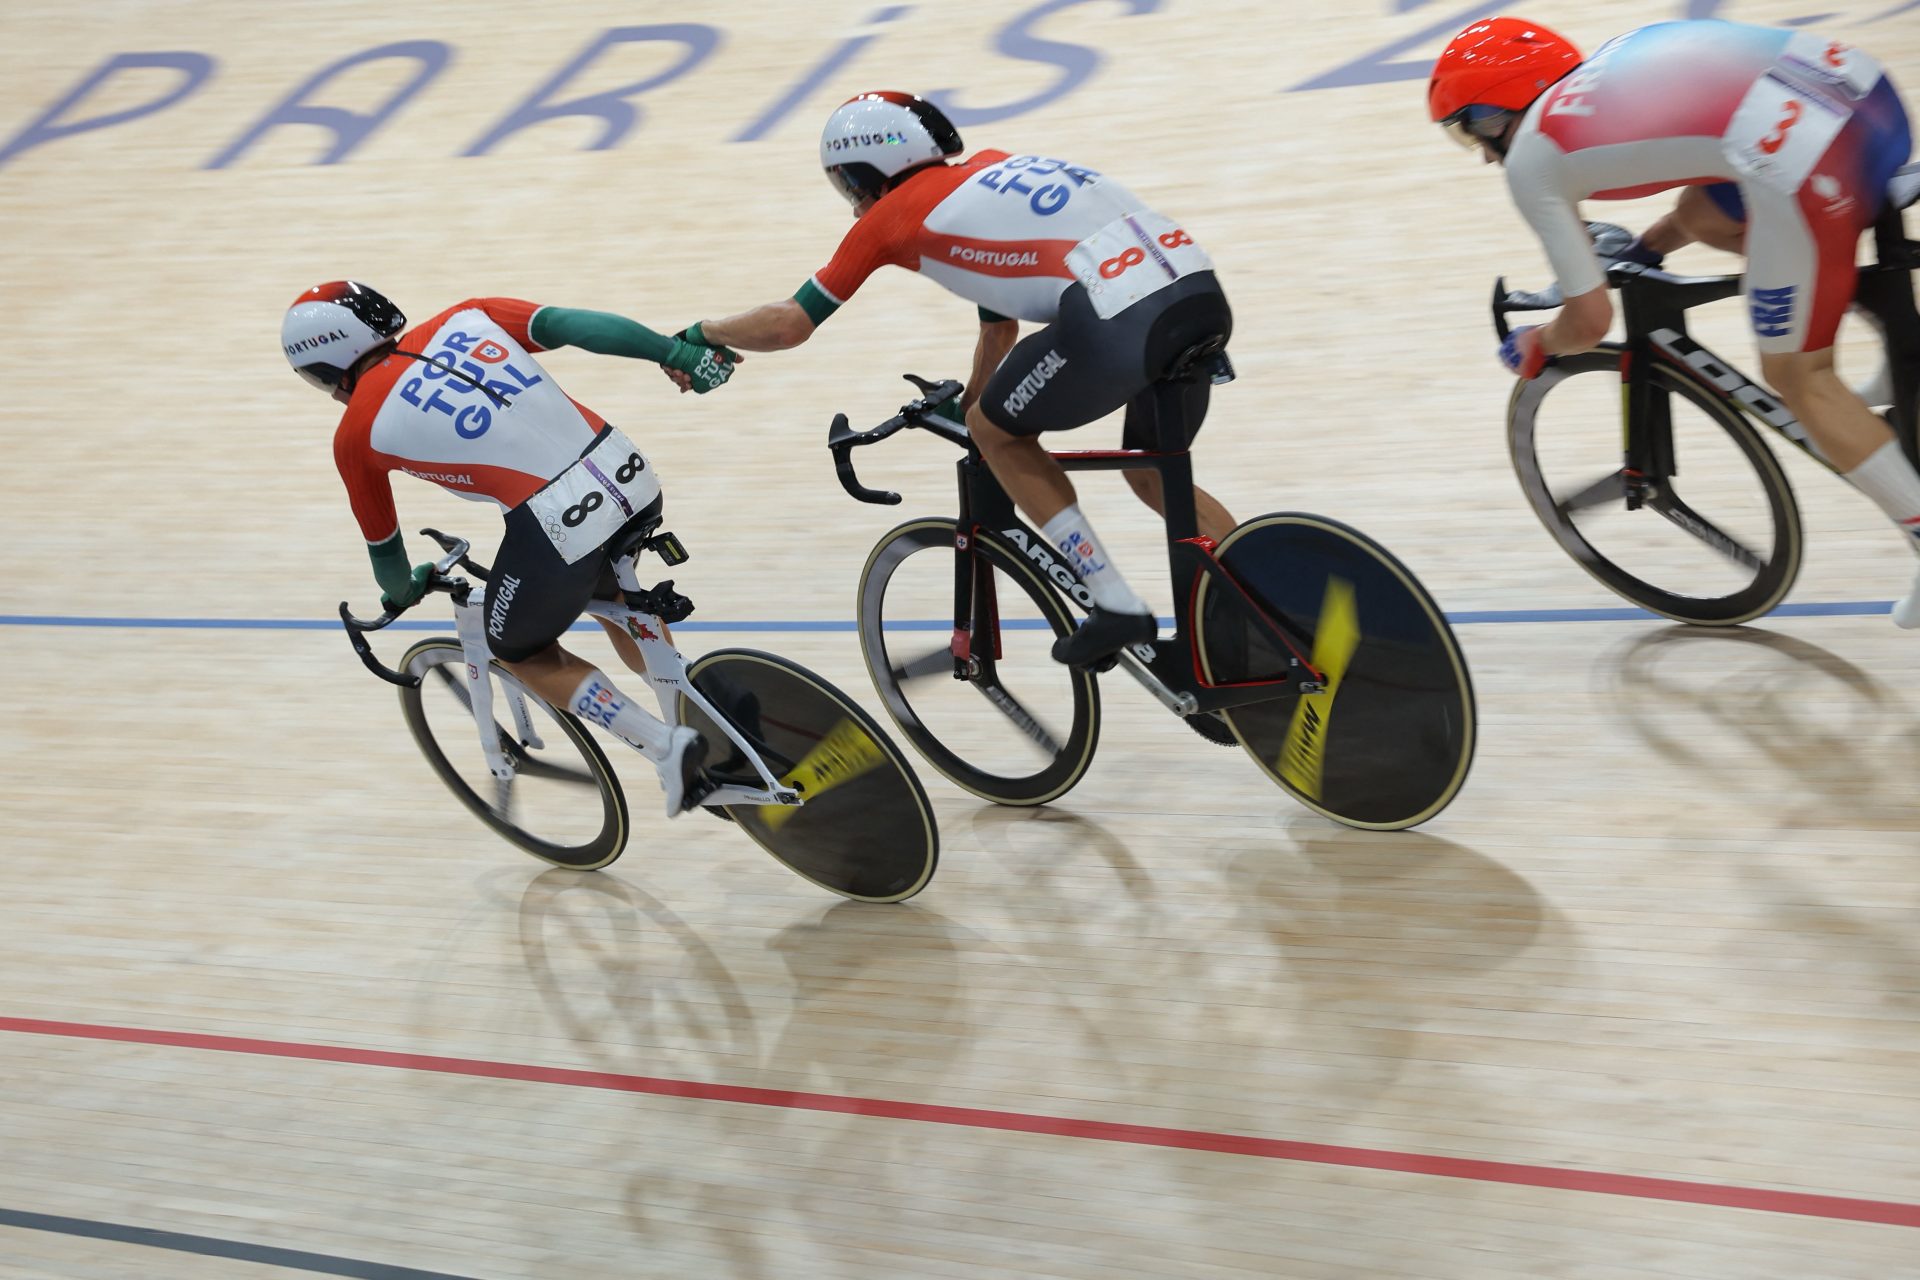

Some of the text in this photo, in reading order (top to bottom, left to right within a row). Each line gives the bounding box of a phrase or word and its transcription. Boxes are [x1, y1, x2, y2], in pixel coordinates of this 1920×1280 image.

[825, 131, 908, 151] PORTUGAL
[1758, 100, 1803, 154] 3
[977, 156, 1039, 190] PO
[1030, 166, 1103, 216] GA
[949, 245, 1039, 266] PORTUGAL
[1099, 246, 1146, 280] 8
[400, 331, 481, 407] POR
[694, 348, 716, 378] POR
[701, 361, 720, 381] TU
[709, 362, 734, 388] GAL
[422, 360, 485, 417] TU
[455, 364, 542, 439] GAL
[1003, 349, 1067, 418] PORTUGAL
[615, 452, 645, 484] 8
[561, 491, 604, 528] 8
[1001, 529, 1096, 607] ARGO
[488, 573, 521, 640] PORTUGAL
